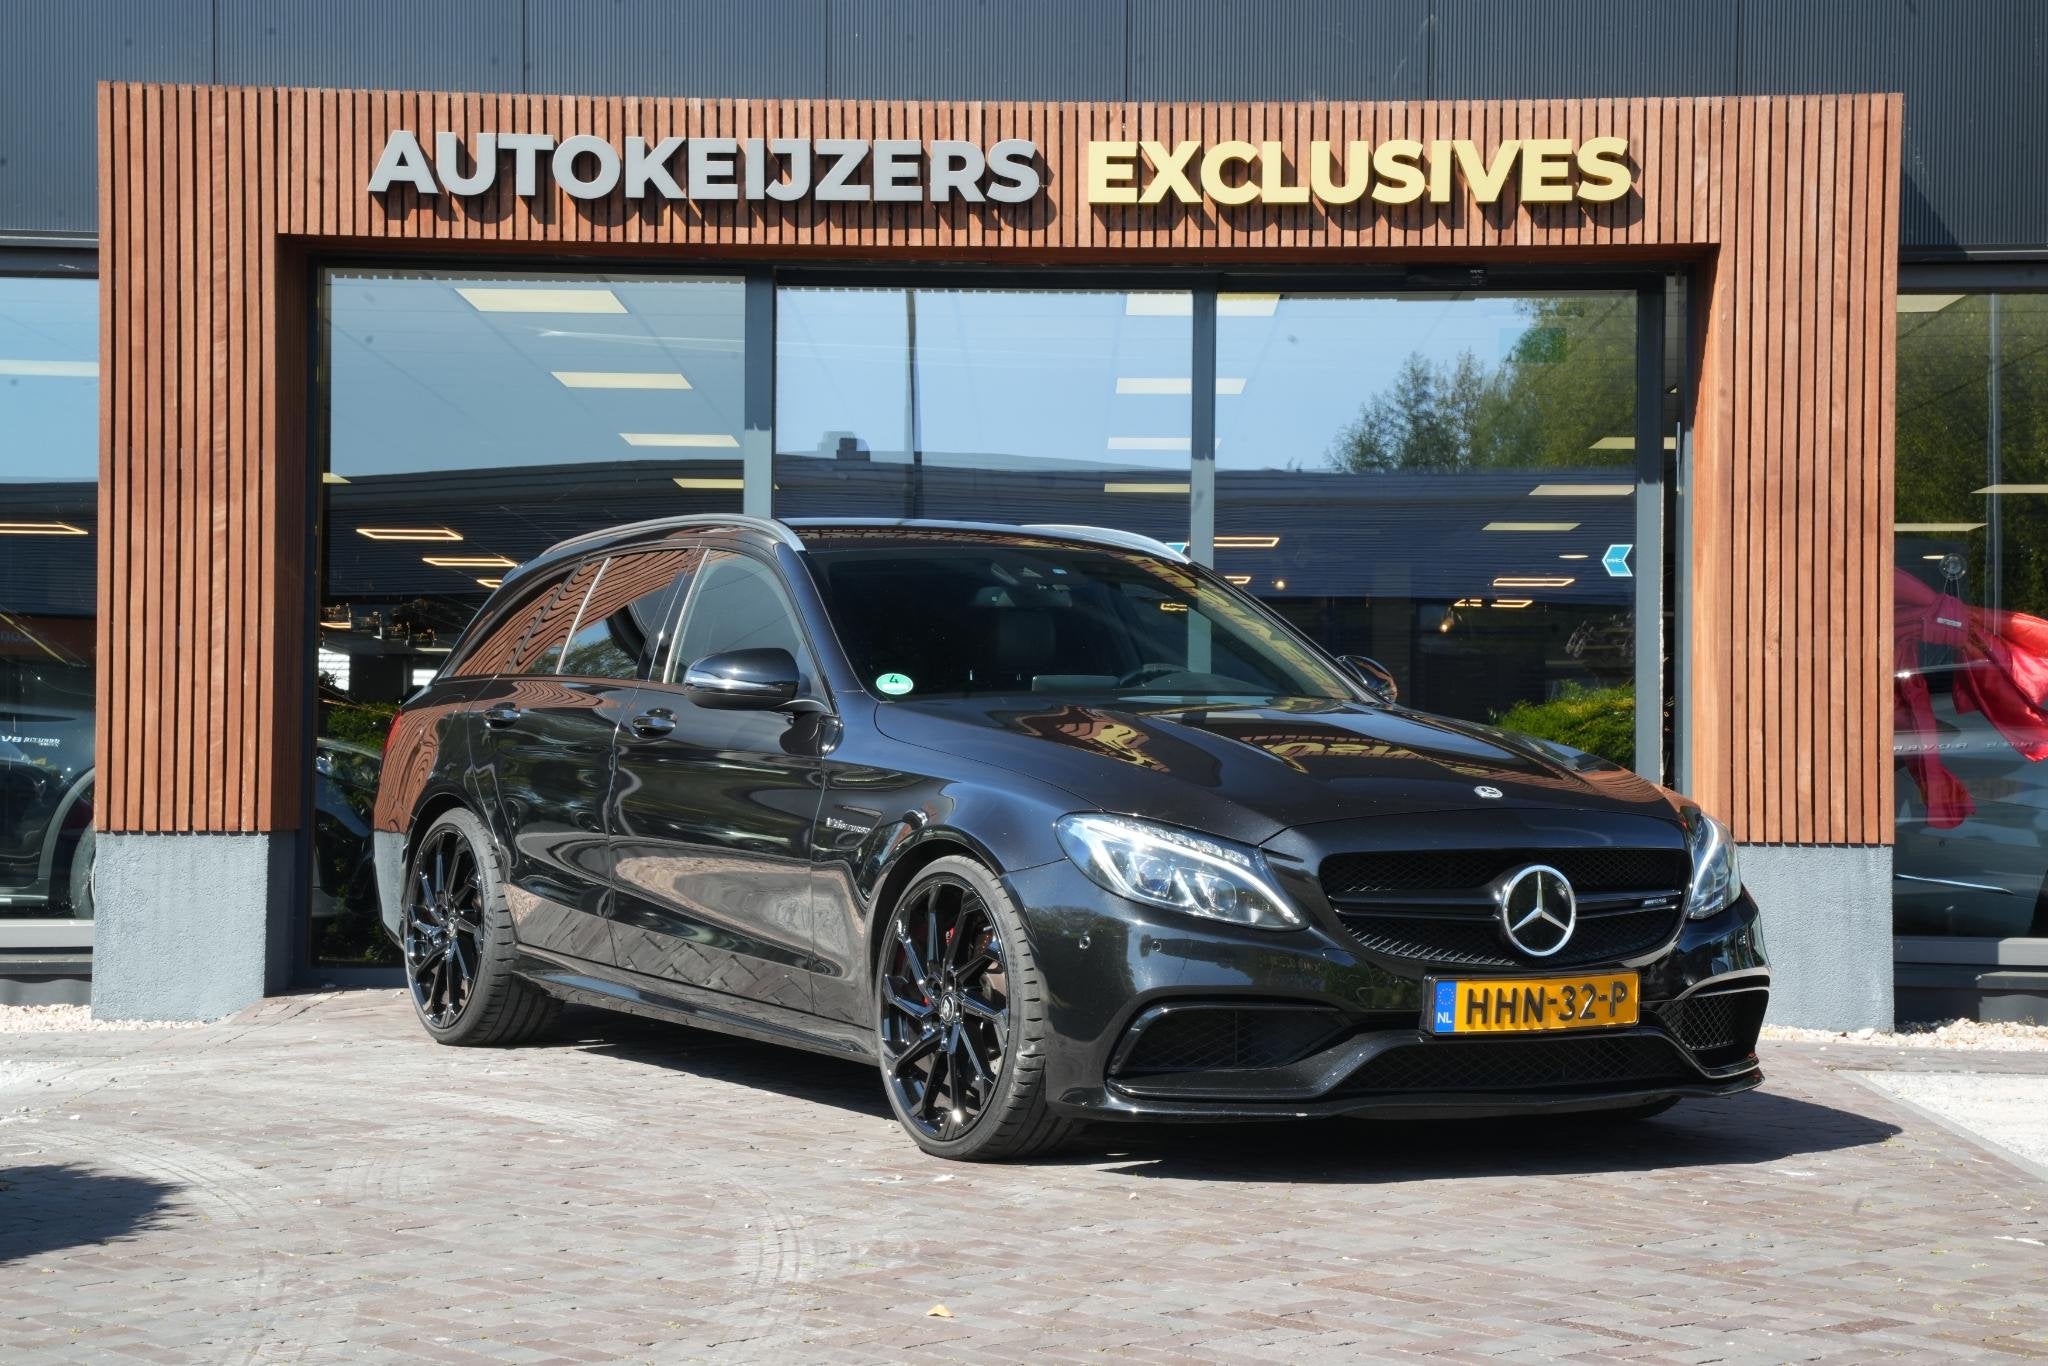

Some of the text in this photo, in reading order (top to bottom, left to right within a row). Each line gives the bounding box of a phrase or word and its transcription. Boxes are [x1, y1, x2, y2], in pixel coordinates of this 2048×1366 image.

[368, 129, 1632, 205] AUTOKEIJZERS EXCLUSIVES
[1437, 1012, 1453, 1024] NL
[1466, 981, 1628, 1024] HHN-32-P
